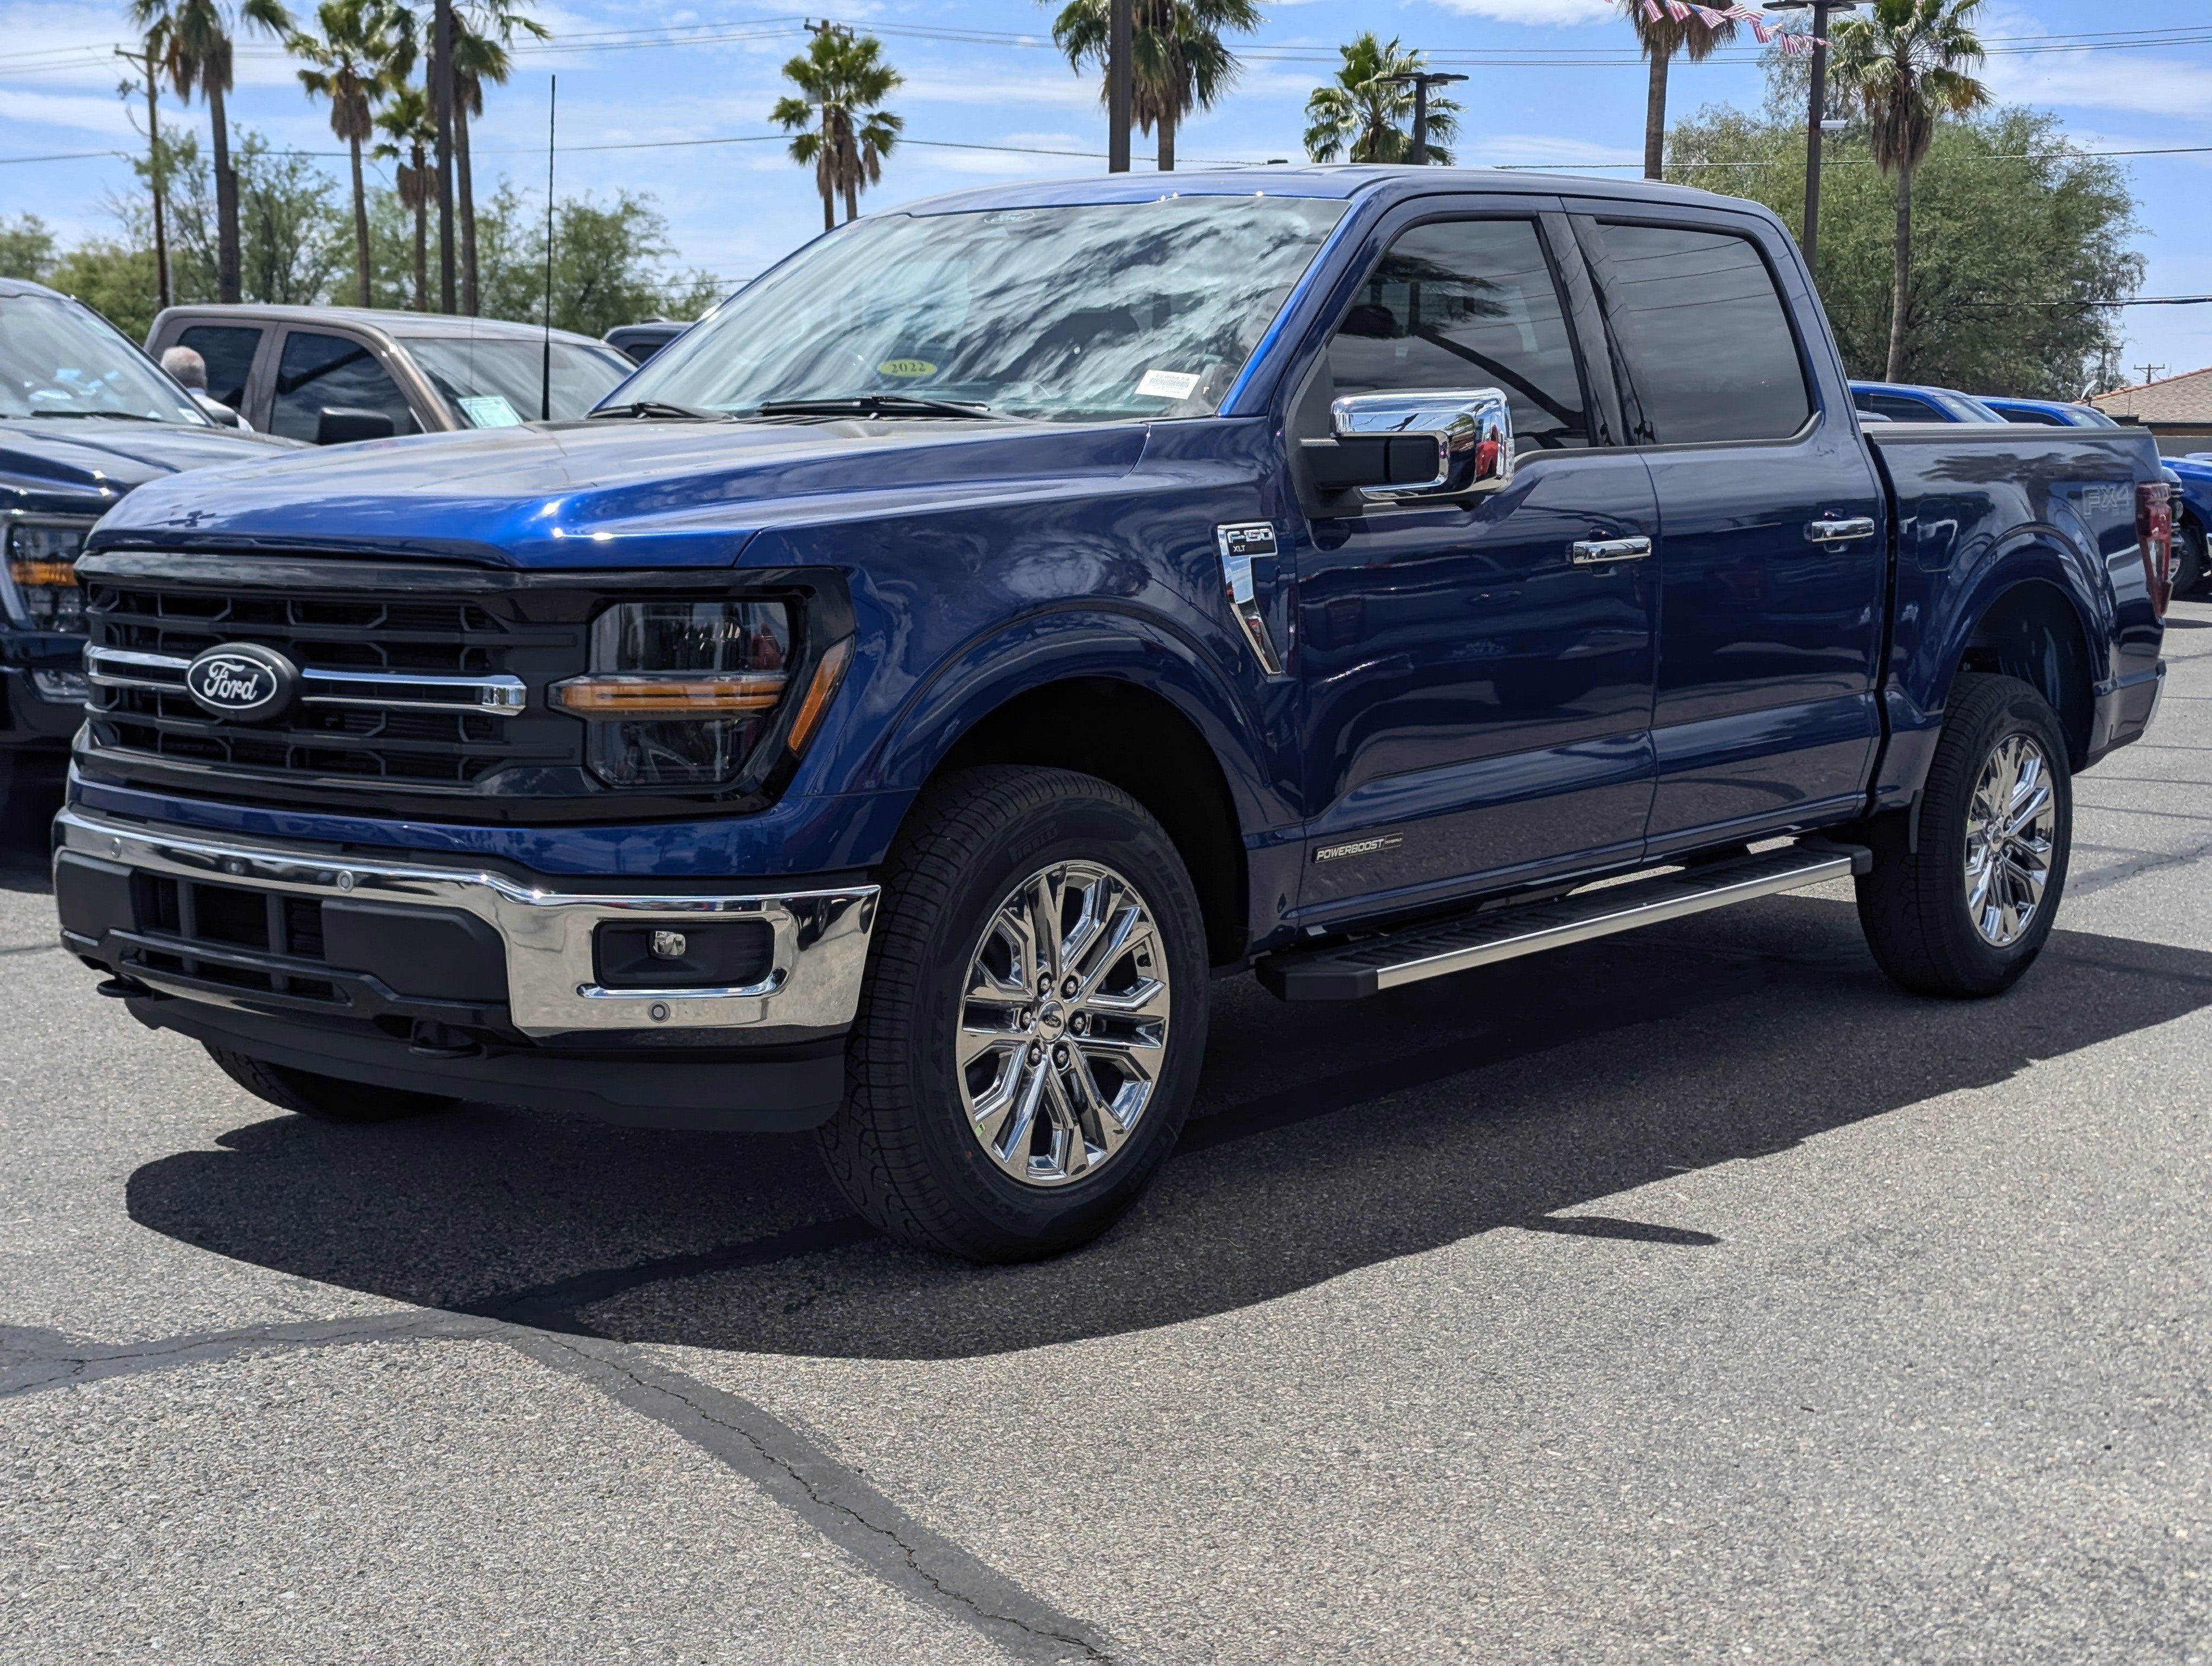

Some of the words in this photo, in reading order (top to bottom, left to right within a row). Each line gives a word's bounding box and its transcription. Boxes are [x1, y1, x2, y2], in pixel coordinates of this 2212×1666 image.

[891, 362, 926, 373] 2022
[2082, 483, 2133, 518] FX4
[1227, 528, 1274, 543] F-150
[1233, 544, 1246, 553] XLT
[203, 661, 259, 701] Ford
[1316, 838, 1385, 861] POWERBOOST
